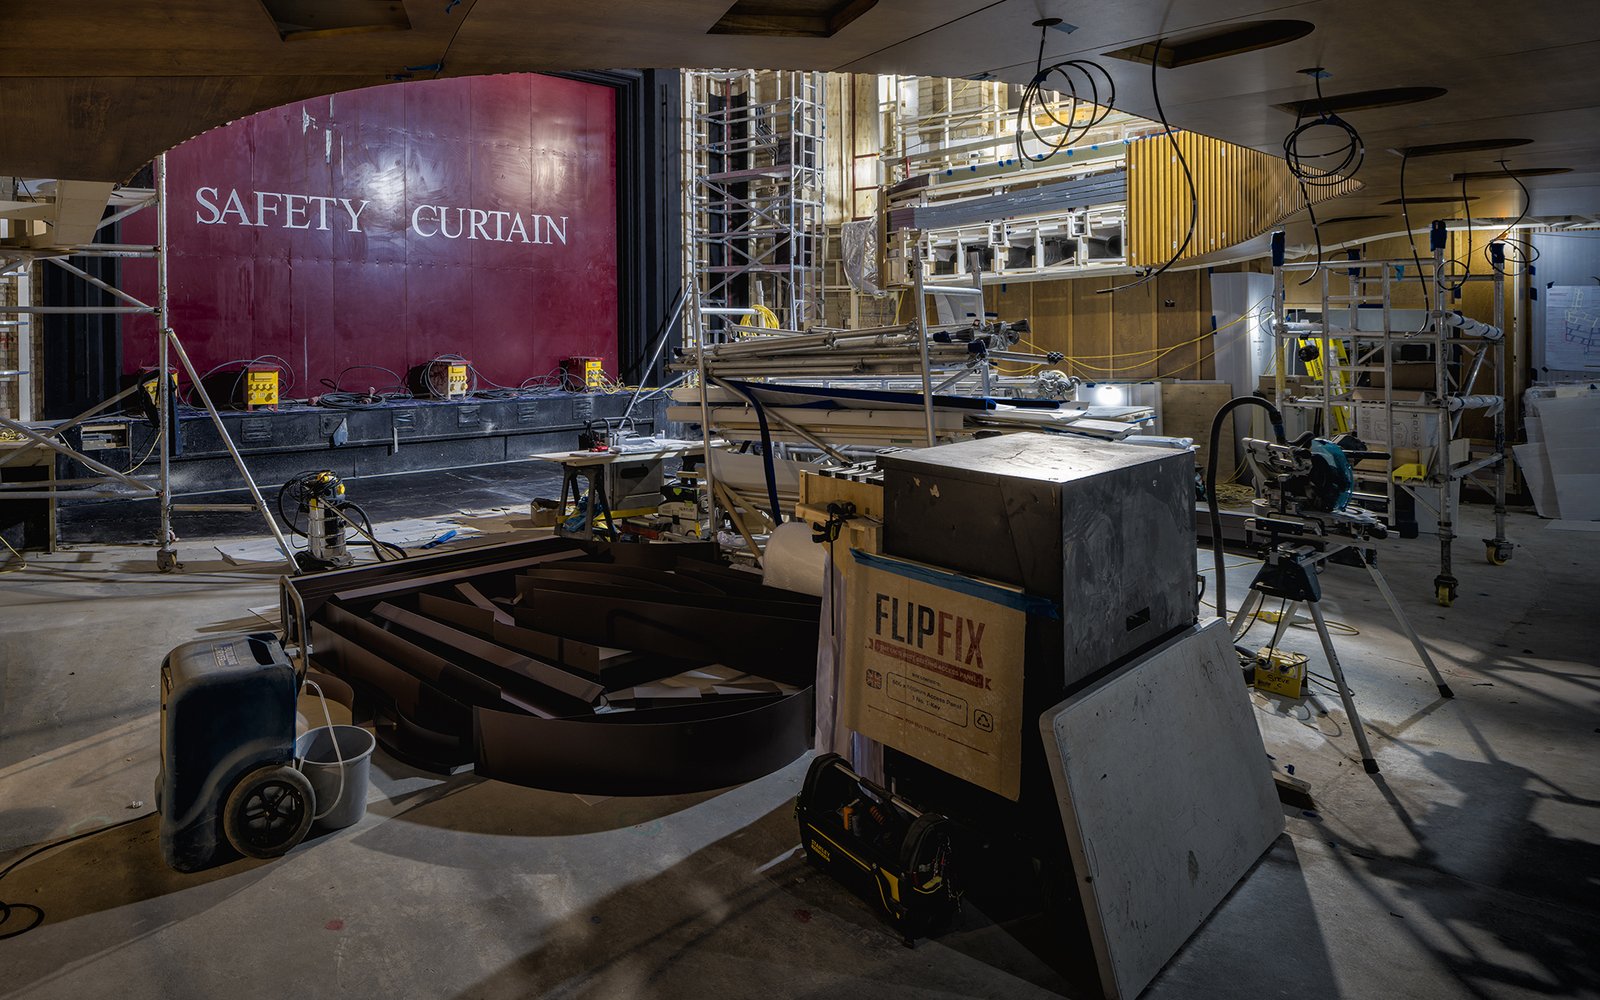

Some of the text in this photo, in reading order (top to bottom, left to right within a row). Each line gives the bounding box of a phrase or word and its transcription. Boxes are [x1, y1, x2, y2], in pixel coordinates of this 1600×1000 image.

[195, 186, 569, 246] SAFETY CURTAIN
[875, 593, 986, 669] FLIPFIX
[926, 692, 945, 704] Access
[946, 699, 962, 710] Panel
